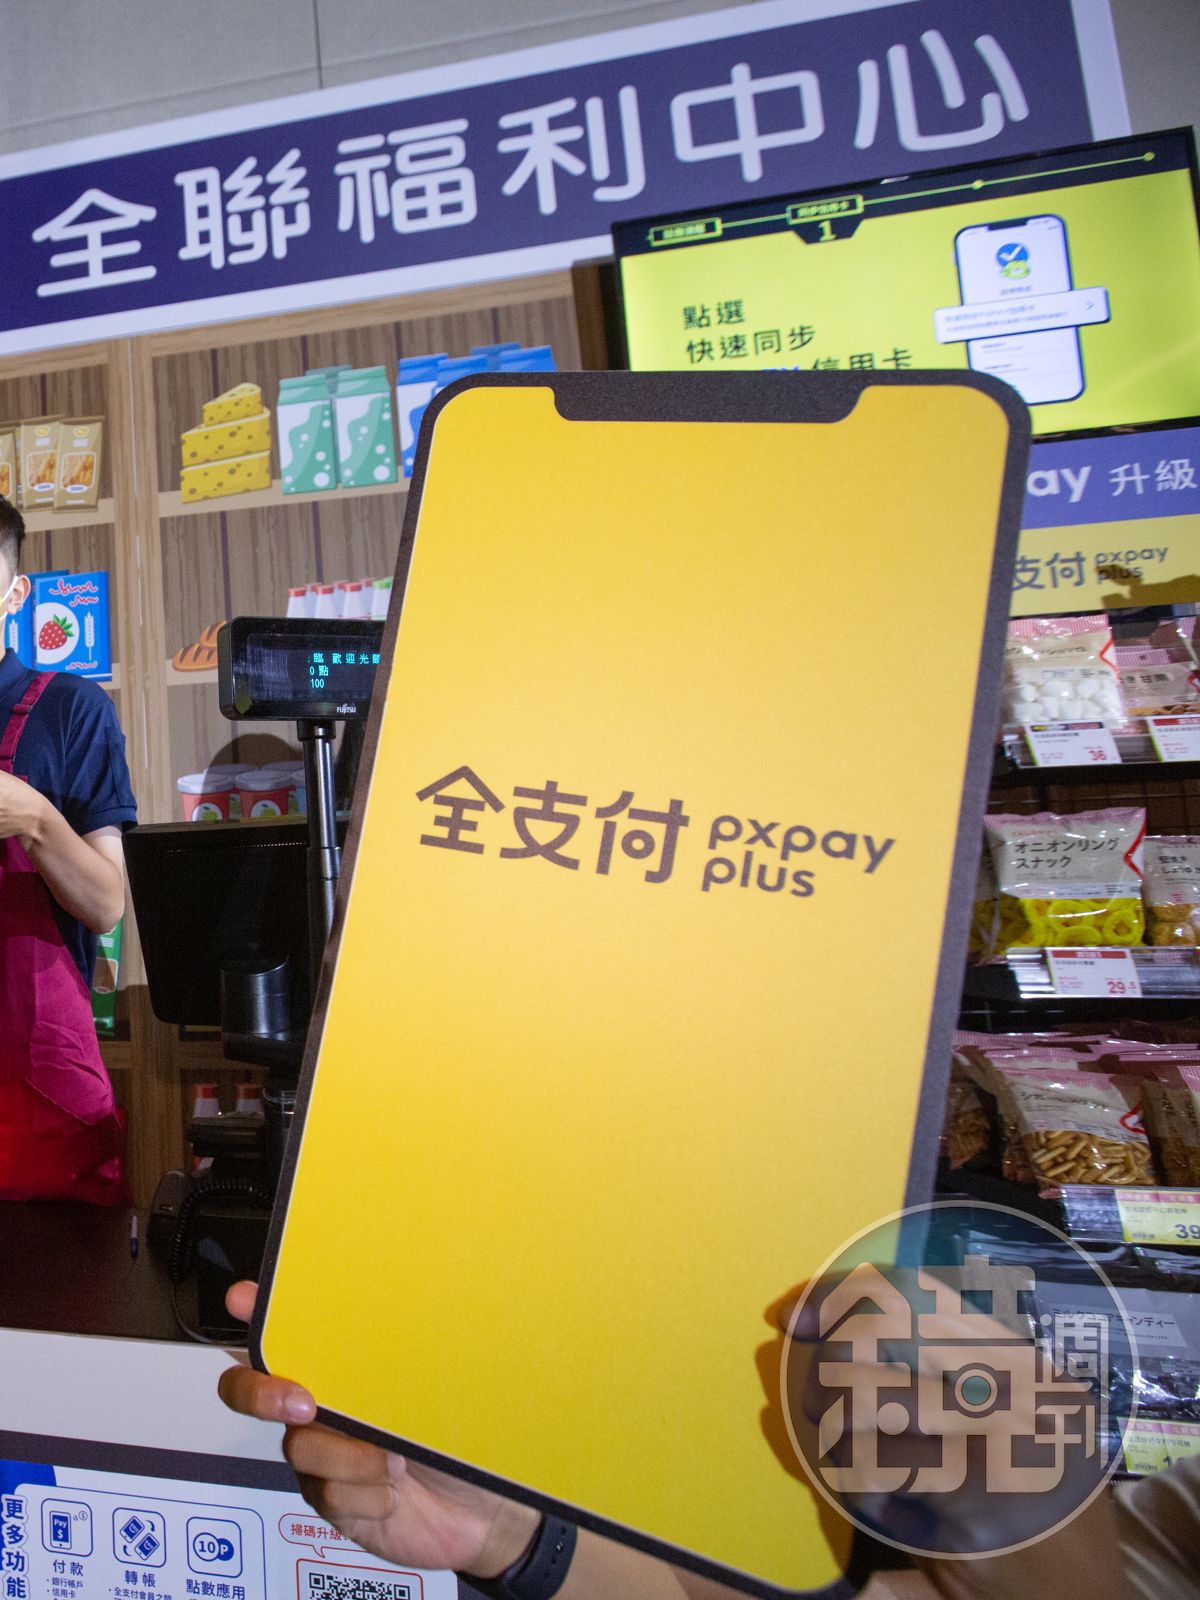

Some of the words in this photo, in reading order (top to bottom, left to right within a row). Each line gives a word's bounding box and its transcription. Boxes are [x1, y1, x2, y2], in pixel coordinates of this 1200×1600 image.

[31, 28, 1029, 298] 全聯福利中心
[818, 220, 837, 242] 1
[682, 299, 745, 330] 點選
[686, 325, 816, 364] 快速同步
[1026, 465, 1091, 503] ay
[1109, 458, 1198, 497] 升級
[1094, 546, 1168, 565] pxpay
[1012, 551, 1086, 592] 支付
[1096, 565, 1143, 585] plus
[310, 678, 325, 688] 100
[336, 703, 357, 715] FUJITSU
[415, 765, 690, 884] 全支付
[708, 814, 896, 874] pxpay
[1014, 837, 1119, 854] オニオンリング
[1015, 855, 1072, 869] スナック
[701, 851, 816, 898] plus
[1107, 981, 1127, 994] 29
[54, 1518, 68, 1529] Pay
[5, 1496, 27, 1600] 更多功能
[198, 1540, 215, 1554] 10
[52, 1559, 84, 1577] 付款
[124, 1569, 156, 1588] 轉帳
[52, 1588, 76, 1598] 信用卡
[186, 1578, 246, 1600] 點數應用
